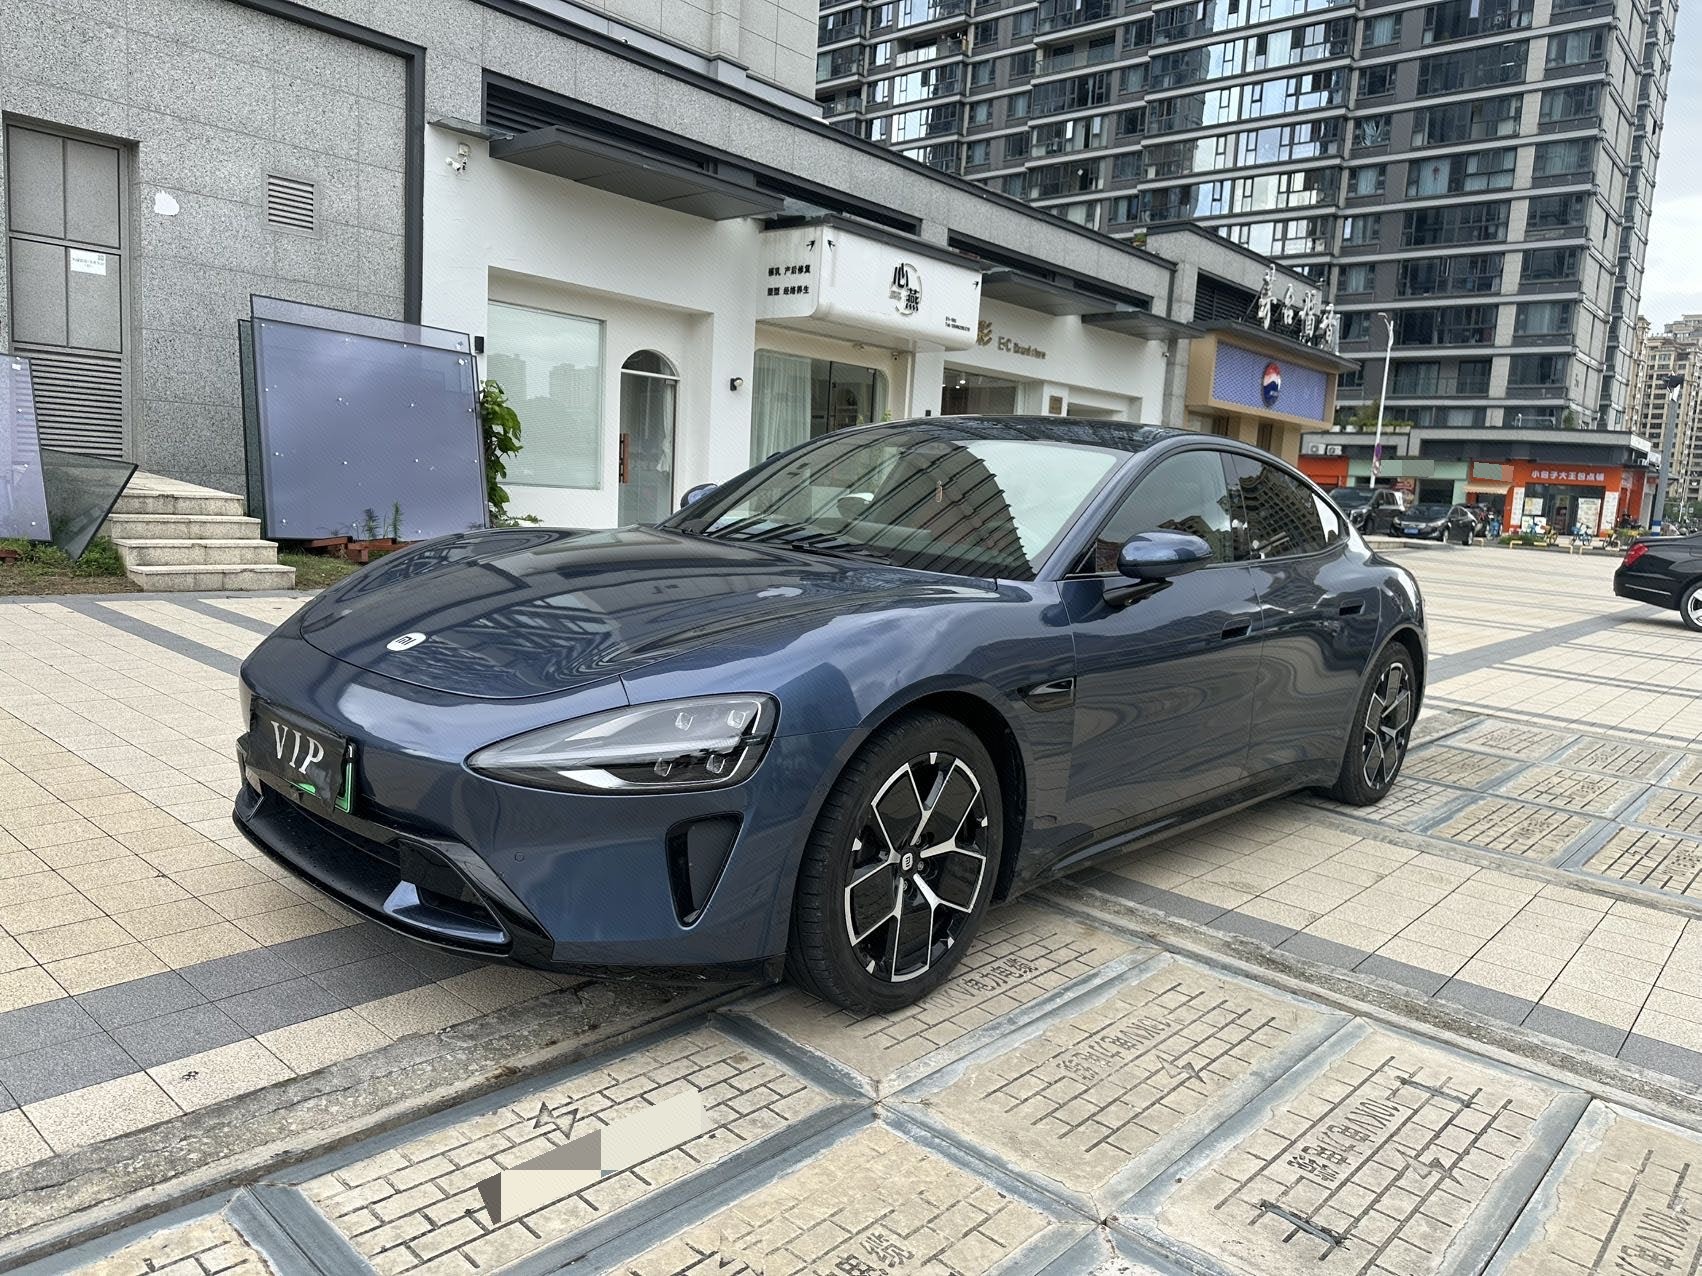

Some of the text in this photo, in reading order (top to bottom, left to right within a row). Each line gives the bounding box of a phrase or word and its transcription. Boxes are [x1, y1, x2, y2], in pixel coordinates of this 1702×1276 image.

[270, 720, 325, 775] VIP
[1286, 1098, 1400, 1182] 10KV电力电缆
